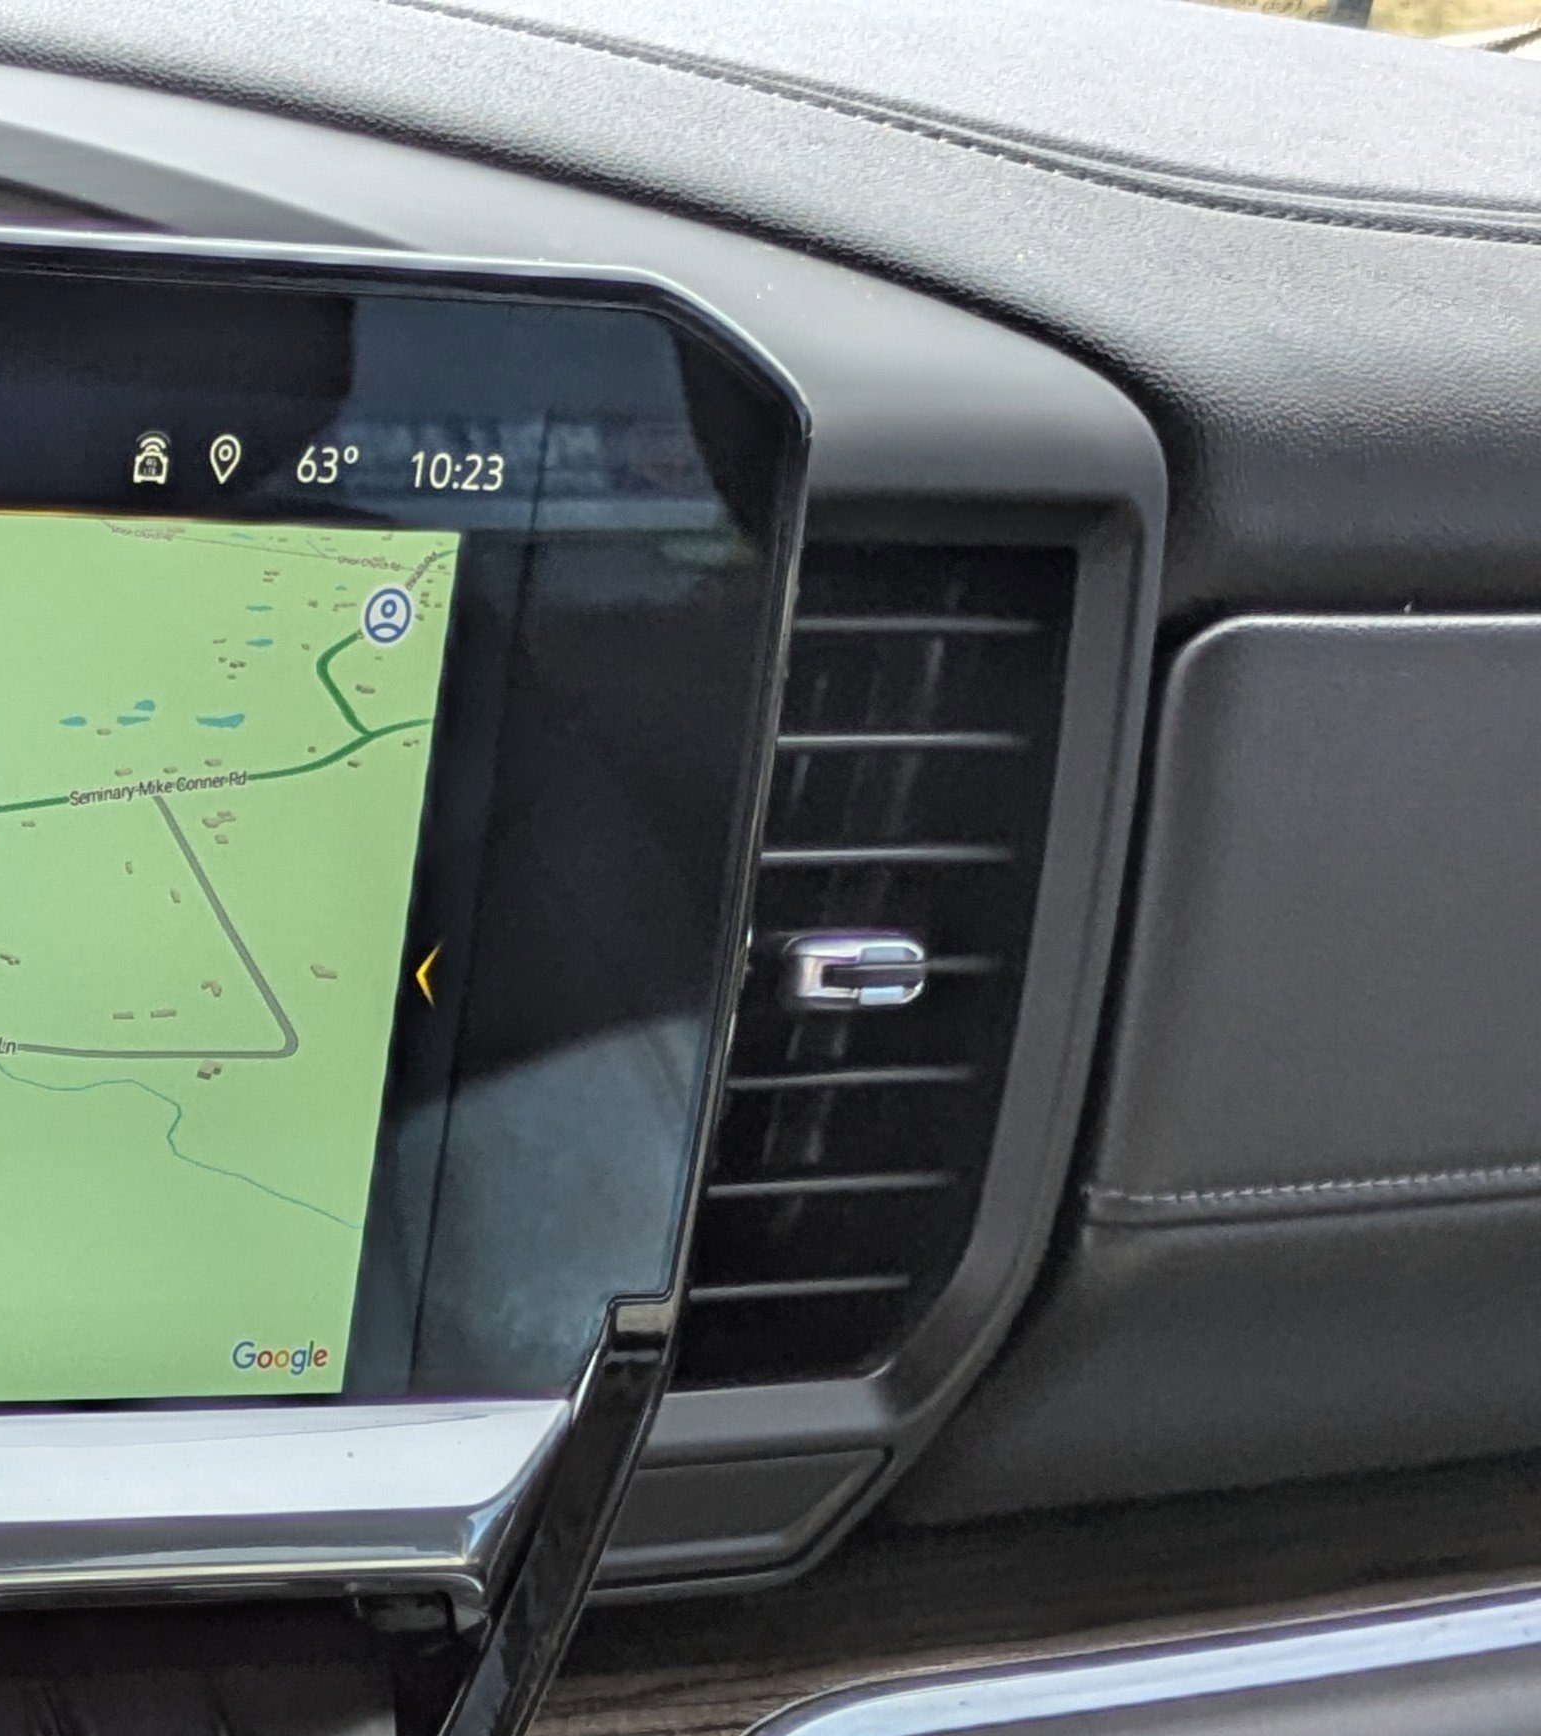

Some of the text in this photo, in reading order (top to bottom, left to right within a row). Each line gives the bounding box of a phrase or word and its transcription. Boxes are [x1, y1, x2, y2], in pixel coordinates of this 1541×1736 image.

[296, 445, 360, 484] 63°
[411, 451, 505, 491] 10:23
[176, 774, 226, 791] Conner
[229, 771, 247, 786] Rd
[232, 1340, 328, 1376] Google
